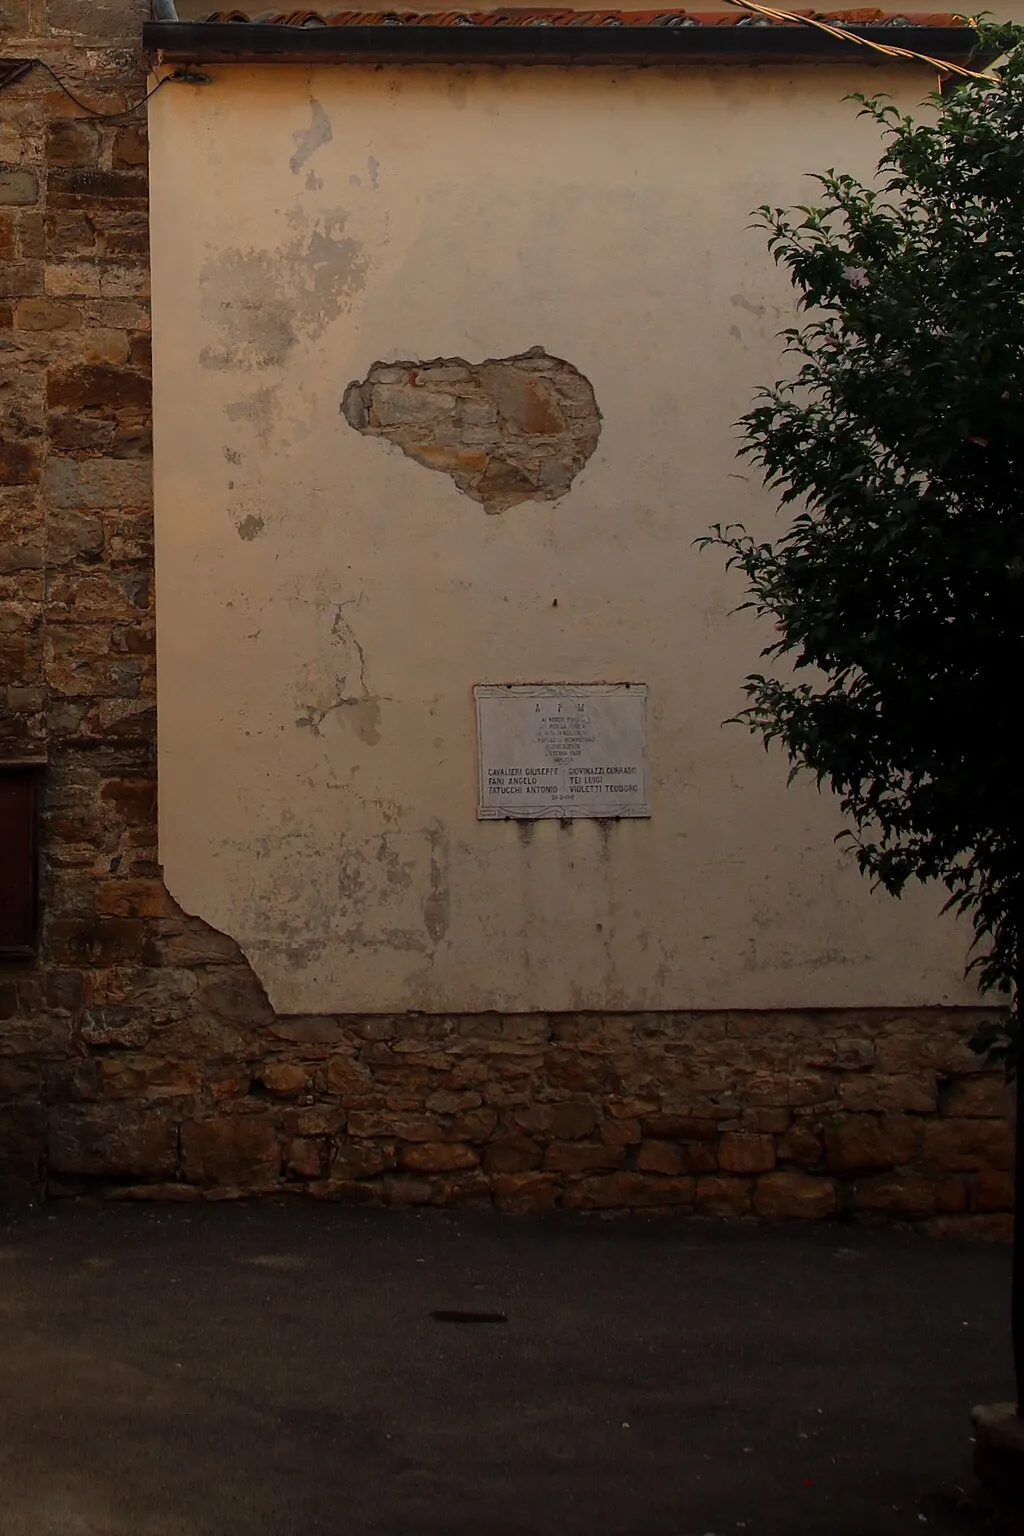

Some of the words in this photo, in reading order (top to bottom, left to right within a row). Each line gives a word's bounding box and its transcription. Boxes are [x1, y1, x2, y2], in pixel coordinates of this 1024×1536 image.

[487, 768, 522, 776] CAVALIERI
[525, 767, 559, 775] GIUSEPPE
[488, 777, 505, 785] FANI
[508, 777, 537, 785] ANGELO
[569, 777, 582, 785] TEI
[584, 776, 603, 784] LUIGI
[488, 786, 523, 794] FATUCCHI
[525, 786, 558, 794] ANTONIO
[569, 785, 602, 793] VIOLETTI
[605, 784, 638, 793] TEODORO
